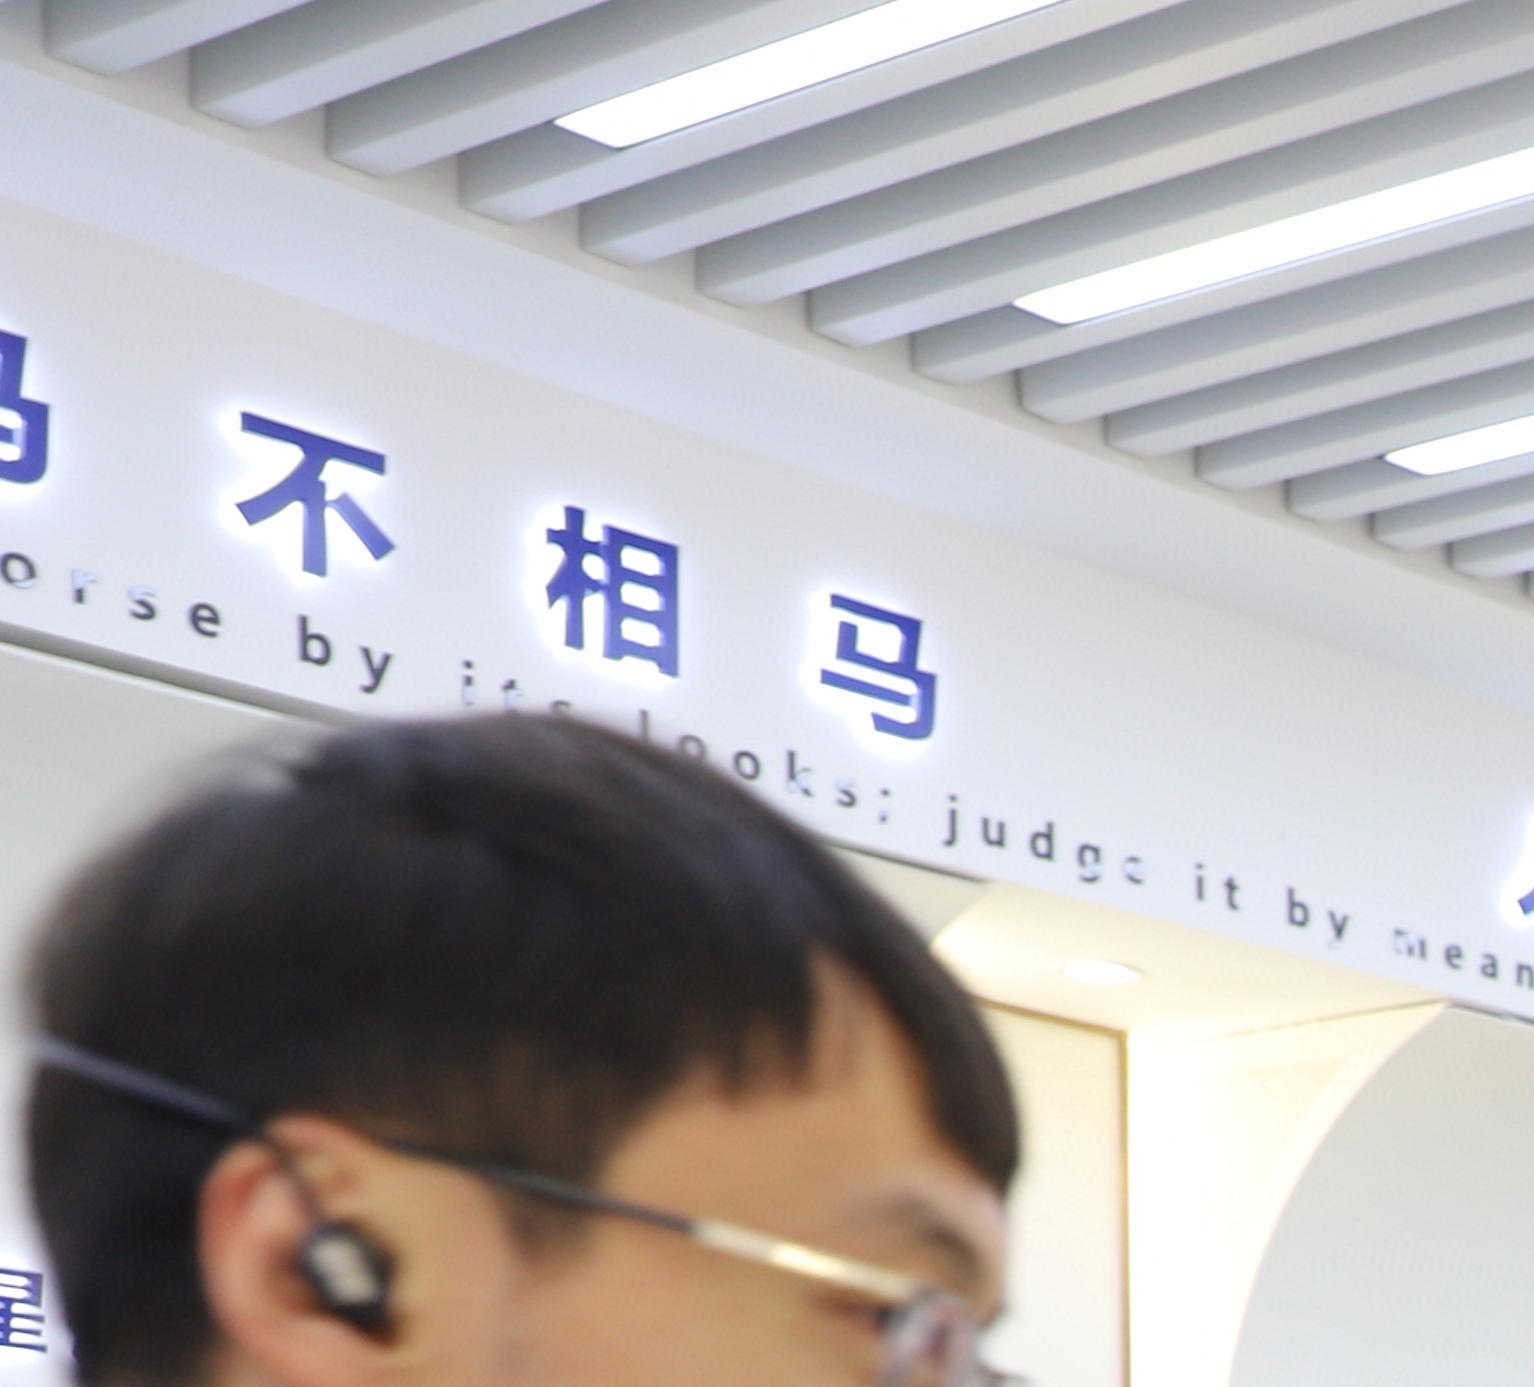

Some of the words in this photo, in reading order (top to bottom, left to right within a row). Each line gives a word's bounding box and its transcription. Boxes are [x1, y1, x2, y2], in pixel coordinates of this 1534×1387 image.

[296, 613, 396, 694] by
[942, 794, 1145, 884] judge
[1195, 862, 1241, 911] it
[1287, 887, 1350, 948] by
